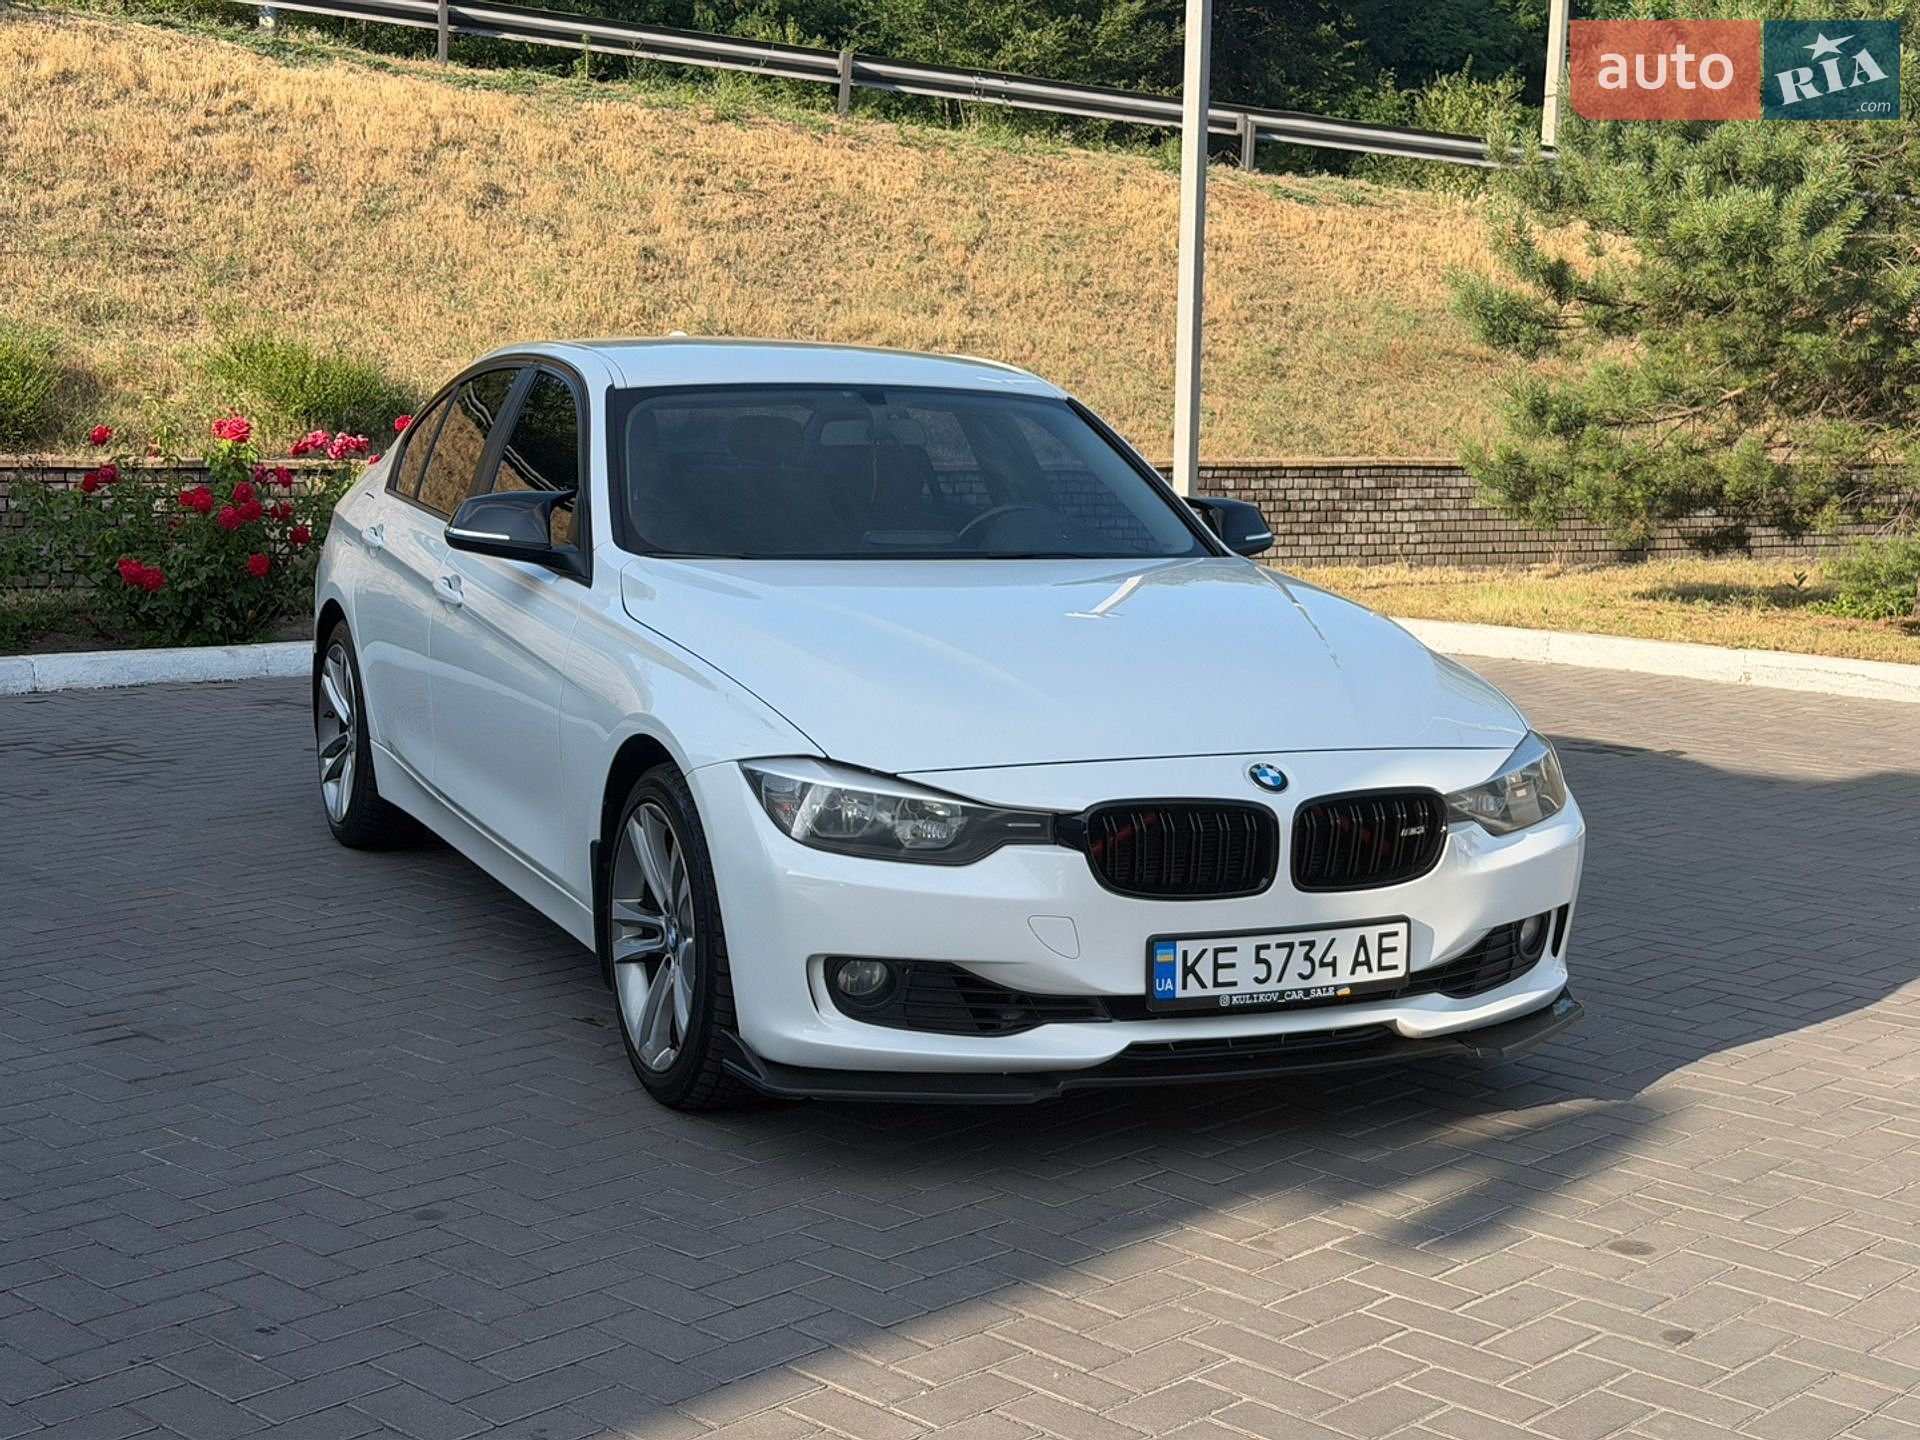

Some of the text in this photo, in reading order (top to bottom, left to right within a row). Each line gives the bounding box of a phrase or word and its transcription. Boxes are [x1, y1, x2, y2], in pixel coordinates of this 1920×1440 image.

[1181, 931, 1399, 990] KE 5734 AE
[1156, 979, 1174, 991] UA
